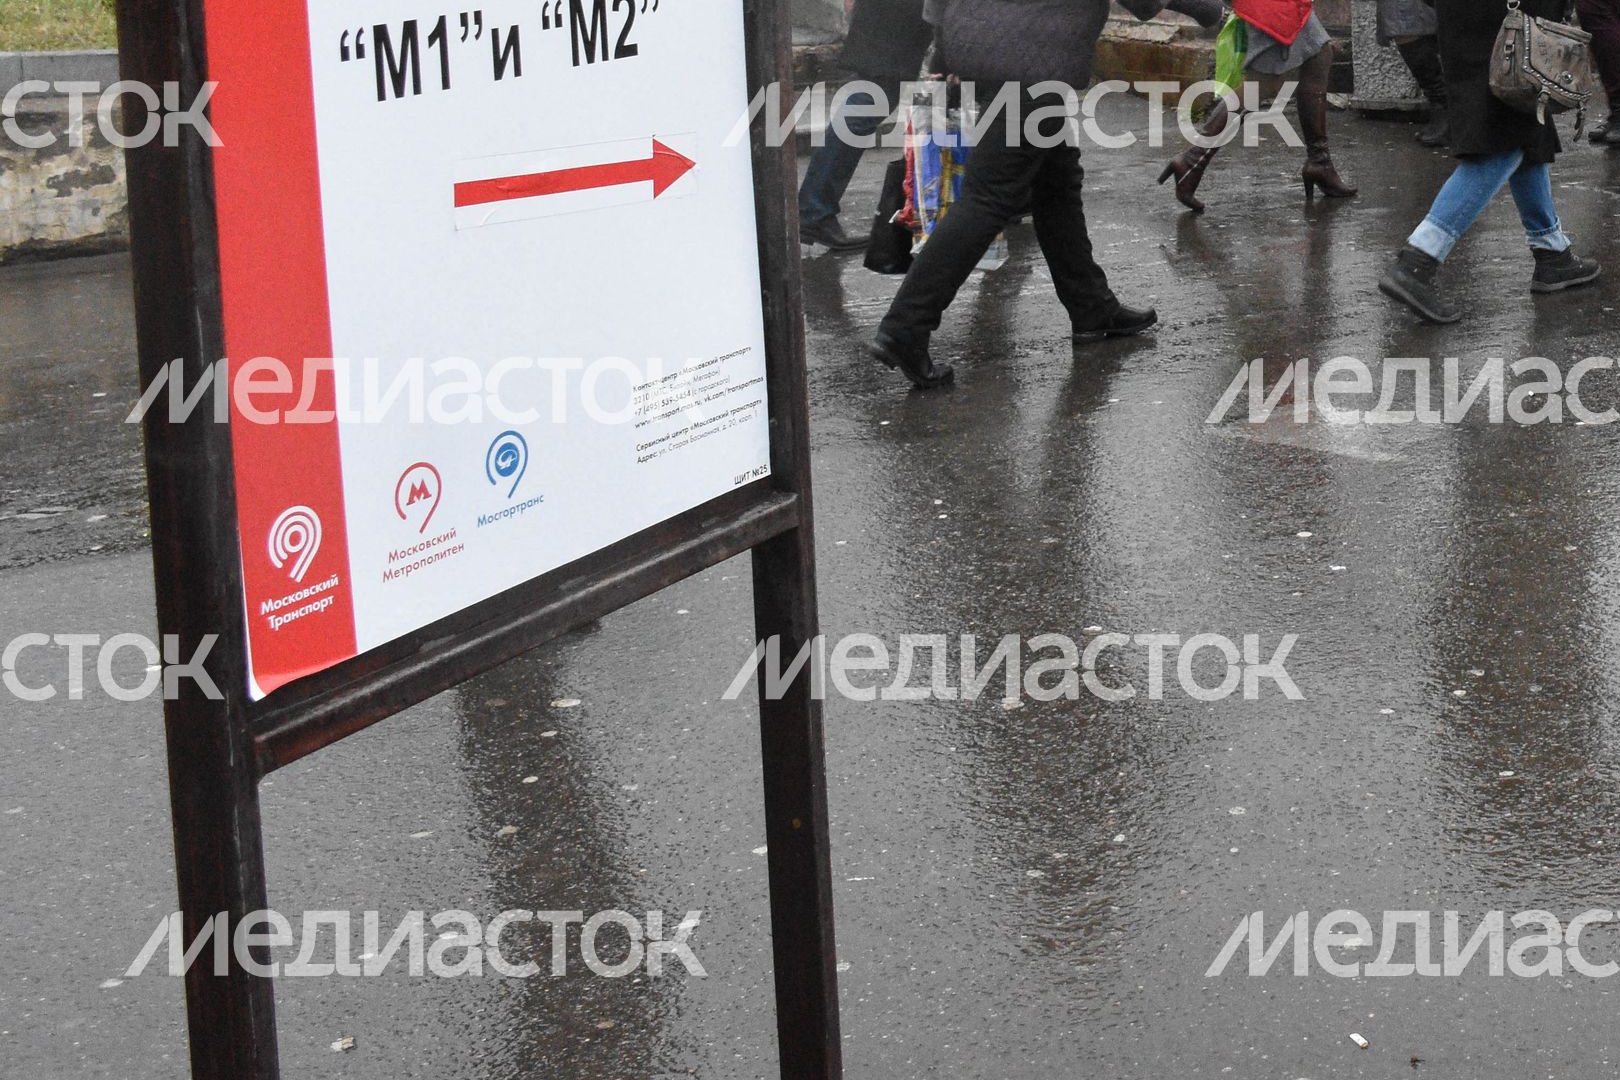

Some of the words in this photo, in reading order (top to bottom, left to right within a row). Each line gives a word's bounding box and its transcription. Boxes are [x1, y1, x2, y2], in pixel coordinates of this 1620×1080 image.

[636, 433, 671, 452] Сервисный
[671, 425, 689, 439] центр
[734, 469, 751, 486] ЩИТ
[751, 463, 768, 479] №25
[476, 493, 544, 528] Мосгортранс
[382, 542, 465, 583] Метрополитен
[388, 527, 457, 564] Московский
[261, 573, 339, 615] Московский
[267, 594, 334, 631] Транспорт
